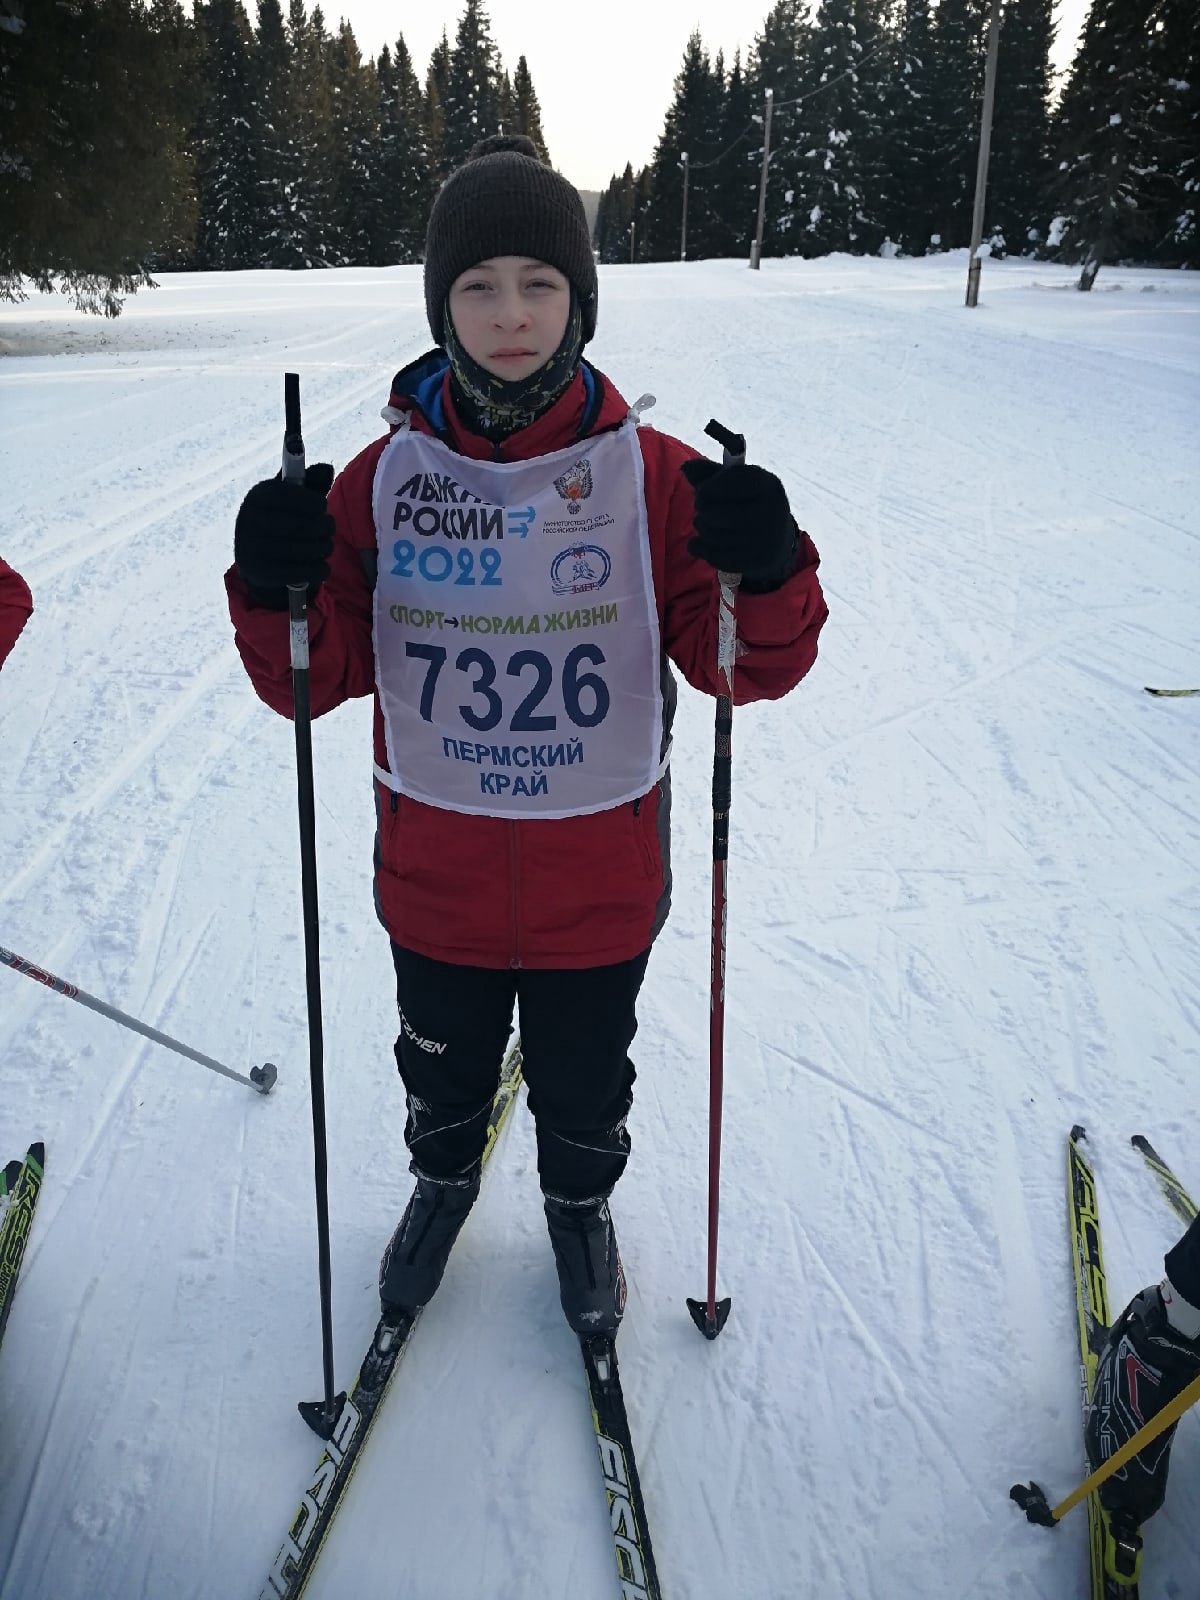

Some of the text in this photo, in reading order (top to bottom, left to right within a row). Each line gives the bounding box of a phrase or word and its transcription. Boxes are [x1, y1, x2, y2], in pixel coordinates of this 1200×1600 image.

[393, 502, 504, 540] РОССИИ
[390, 539, 502, 585] 2022
[390, 603, 618, 634] СПОРТ НОРМА ЖИЗНИ
[406, 643, 610, 731] 7326
[442, 737, 584, 768] ПЕРМСКИЙ
[480, 770, 548, 797] КРАЙ
